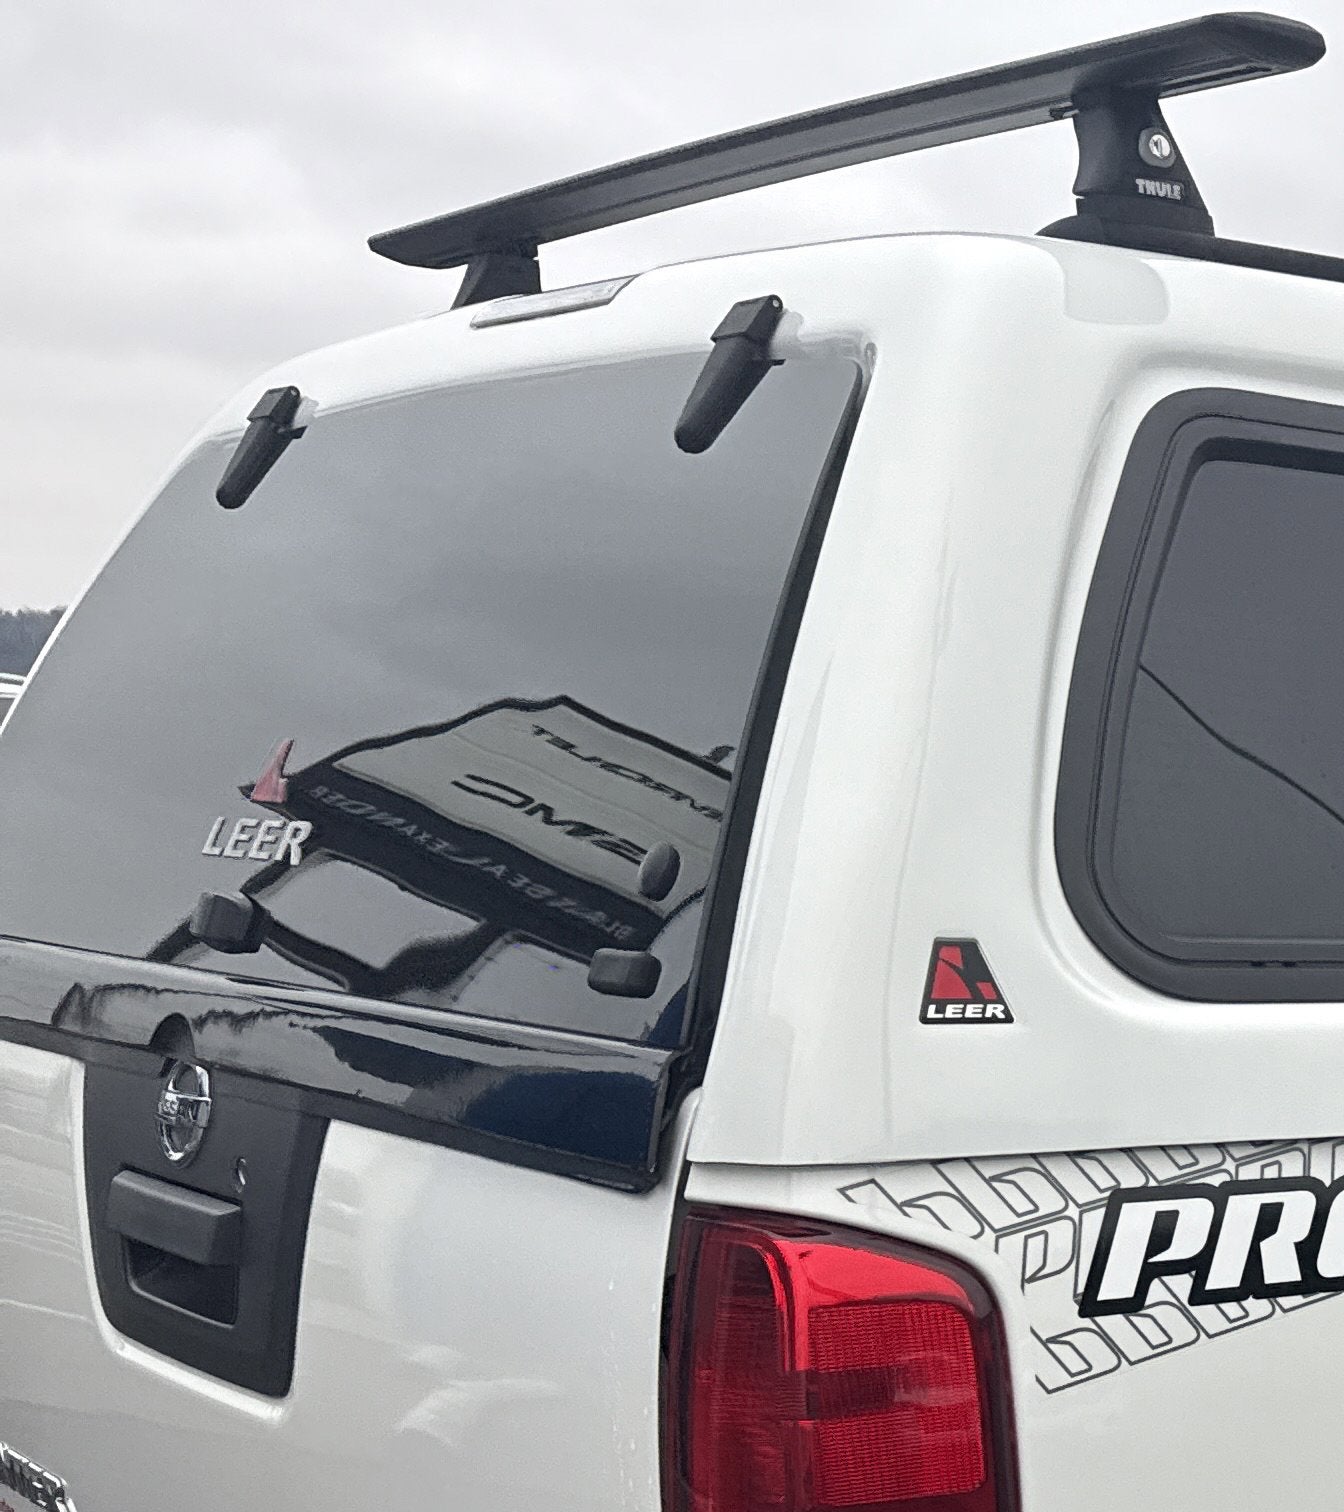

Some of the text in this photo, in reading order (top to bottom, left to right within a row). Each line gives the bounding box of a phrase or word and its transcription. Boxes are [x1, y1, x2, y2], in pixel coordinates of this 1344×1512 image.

[1135, 178, 1182, 201] THULE
[201, 816, 313, 866] LEER
[926, 1003, 1006, 1019] LEER
